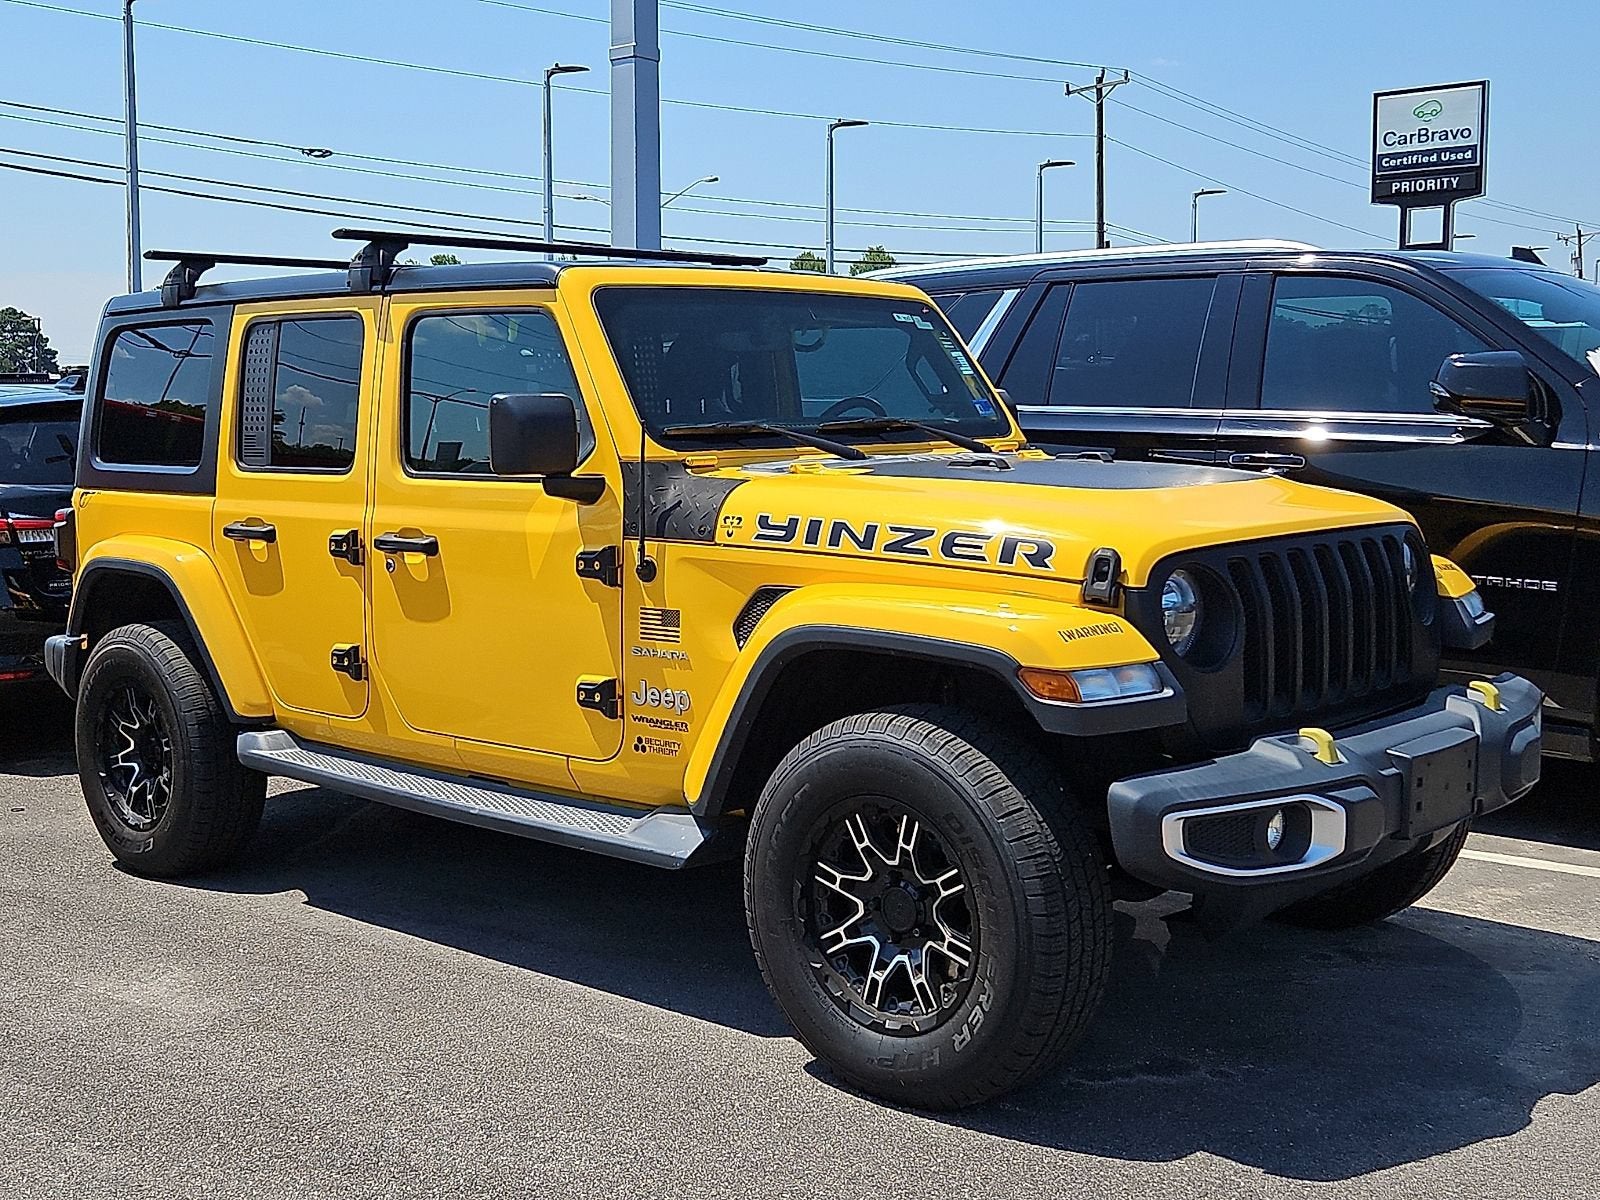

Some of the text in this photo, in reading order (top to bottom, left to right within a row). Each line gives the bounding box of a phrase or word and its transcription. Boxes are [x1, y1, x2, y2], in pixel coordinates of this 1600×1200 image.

[1382, 126, 1472, 147] CarBravo
[1381, 149, 1473, 167] Certified Used
[1391, 176, 1460, 194] PRIORITY
[754, 514, 1056, 570] YINZER
[1471, 574, 1557, 591] TAHOE
[631, 645, 689, 661] SAHARA
[631, 679, 691, 716] Jeep
[631, 714, 689, 729] WRANGLER
